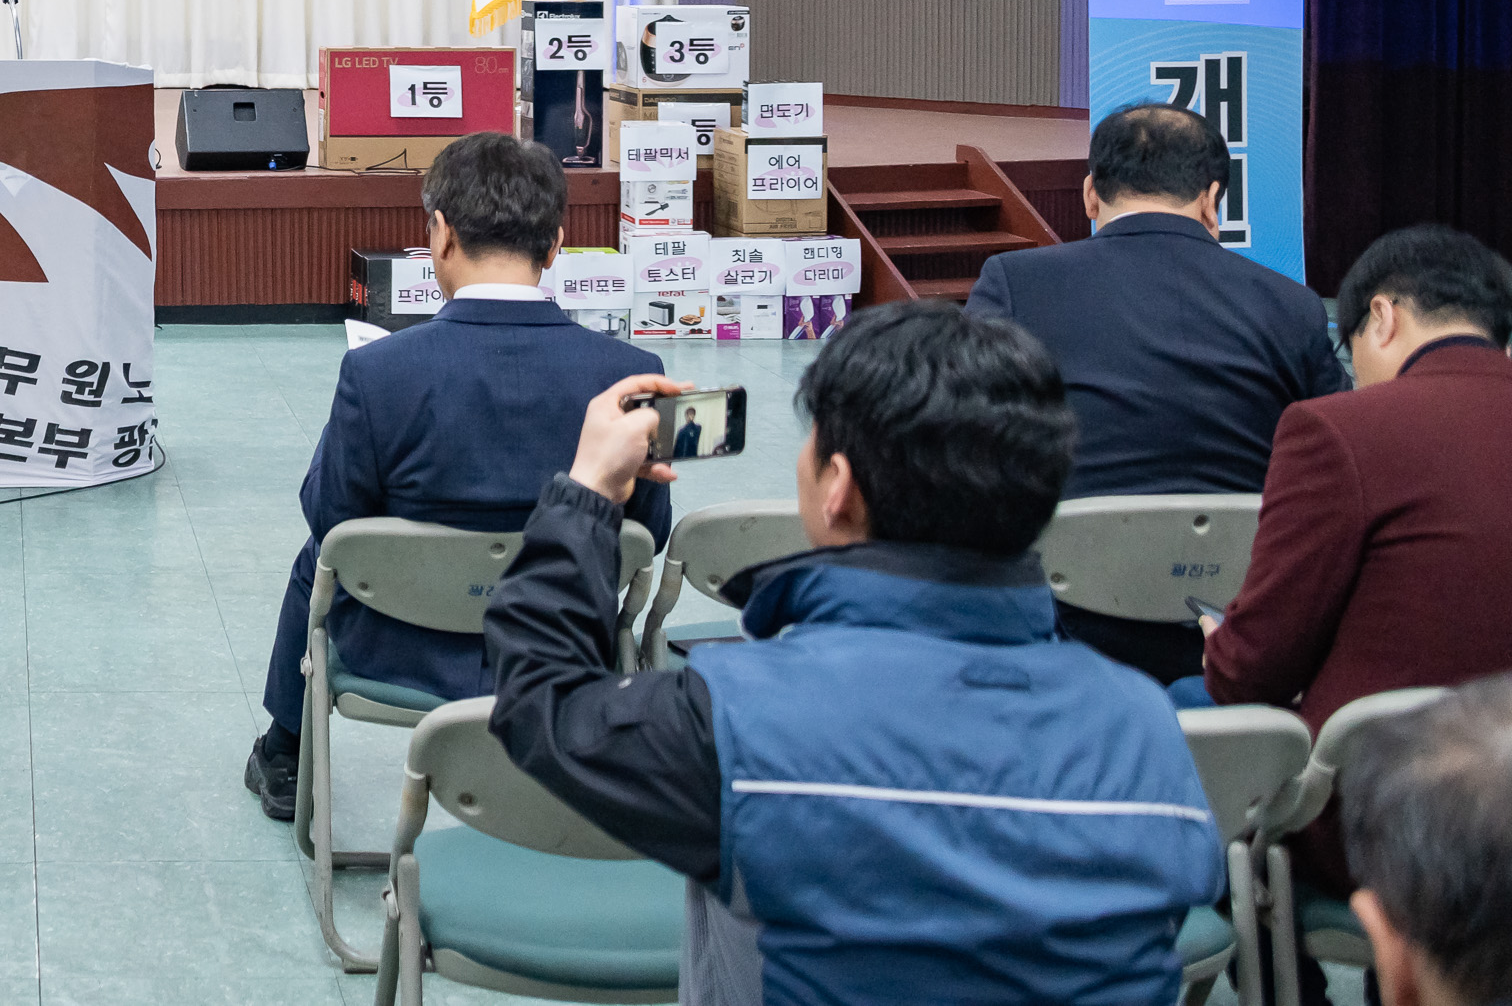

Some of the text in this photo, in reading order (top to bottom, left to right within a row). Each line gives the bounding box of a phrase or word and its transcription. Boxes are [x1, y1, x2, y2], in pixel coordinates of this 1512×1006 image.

[548, 34, 592, 61] 2등
[669, 37, 715, 65] 3등
[335, 57, 399, 68] LG LED TV
[407, 81, 448, 109] 1등
[759, 103, 810, 119] 면도기
[627, 147, 690, 162] 테팔믹서
[768, 154, 801, 170] 에어
[752, 176, 818, 192] 프라이어
[654, 241, 687, 256] 테팔
[803, 246, 843, 260] 핸디형
[731, 249, 763, 264] 칫솔
[647, 266, 696, 283] 토스터
[724, 270, 773, 285] 살균기
[804, 268, 844, 282] 다리미
[563, 279, 626, 294] 멀티포트
